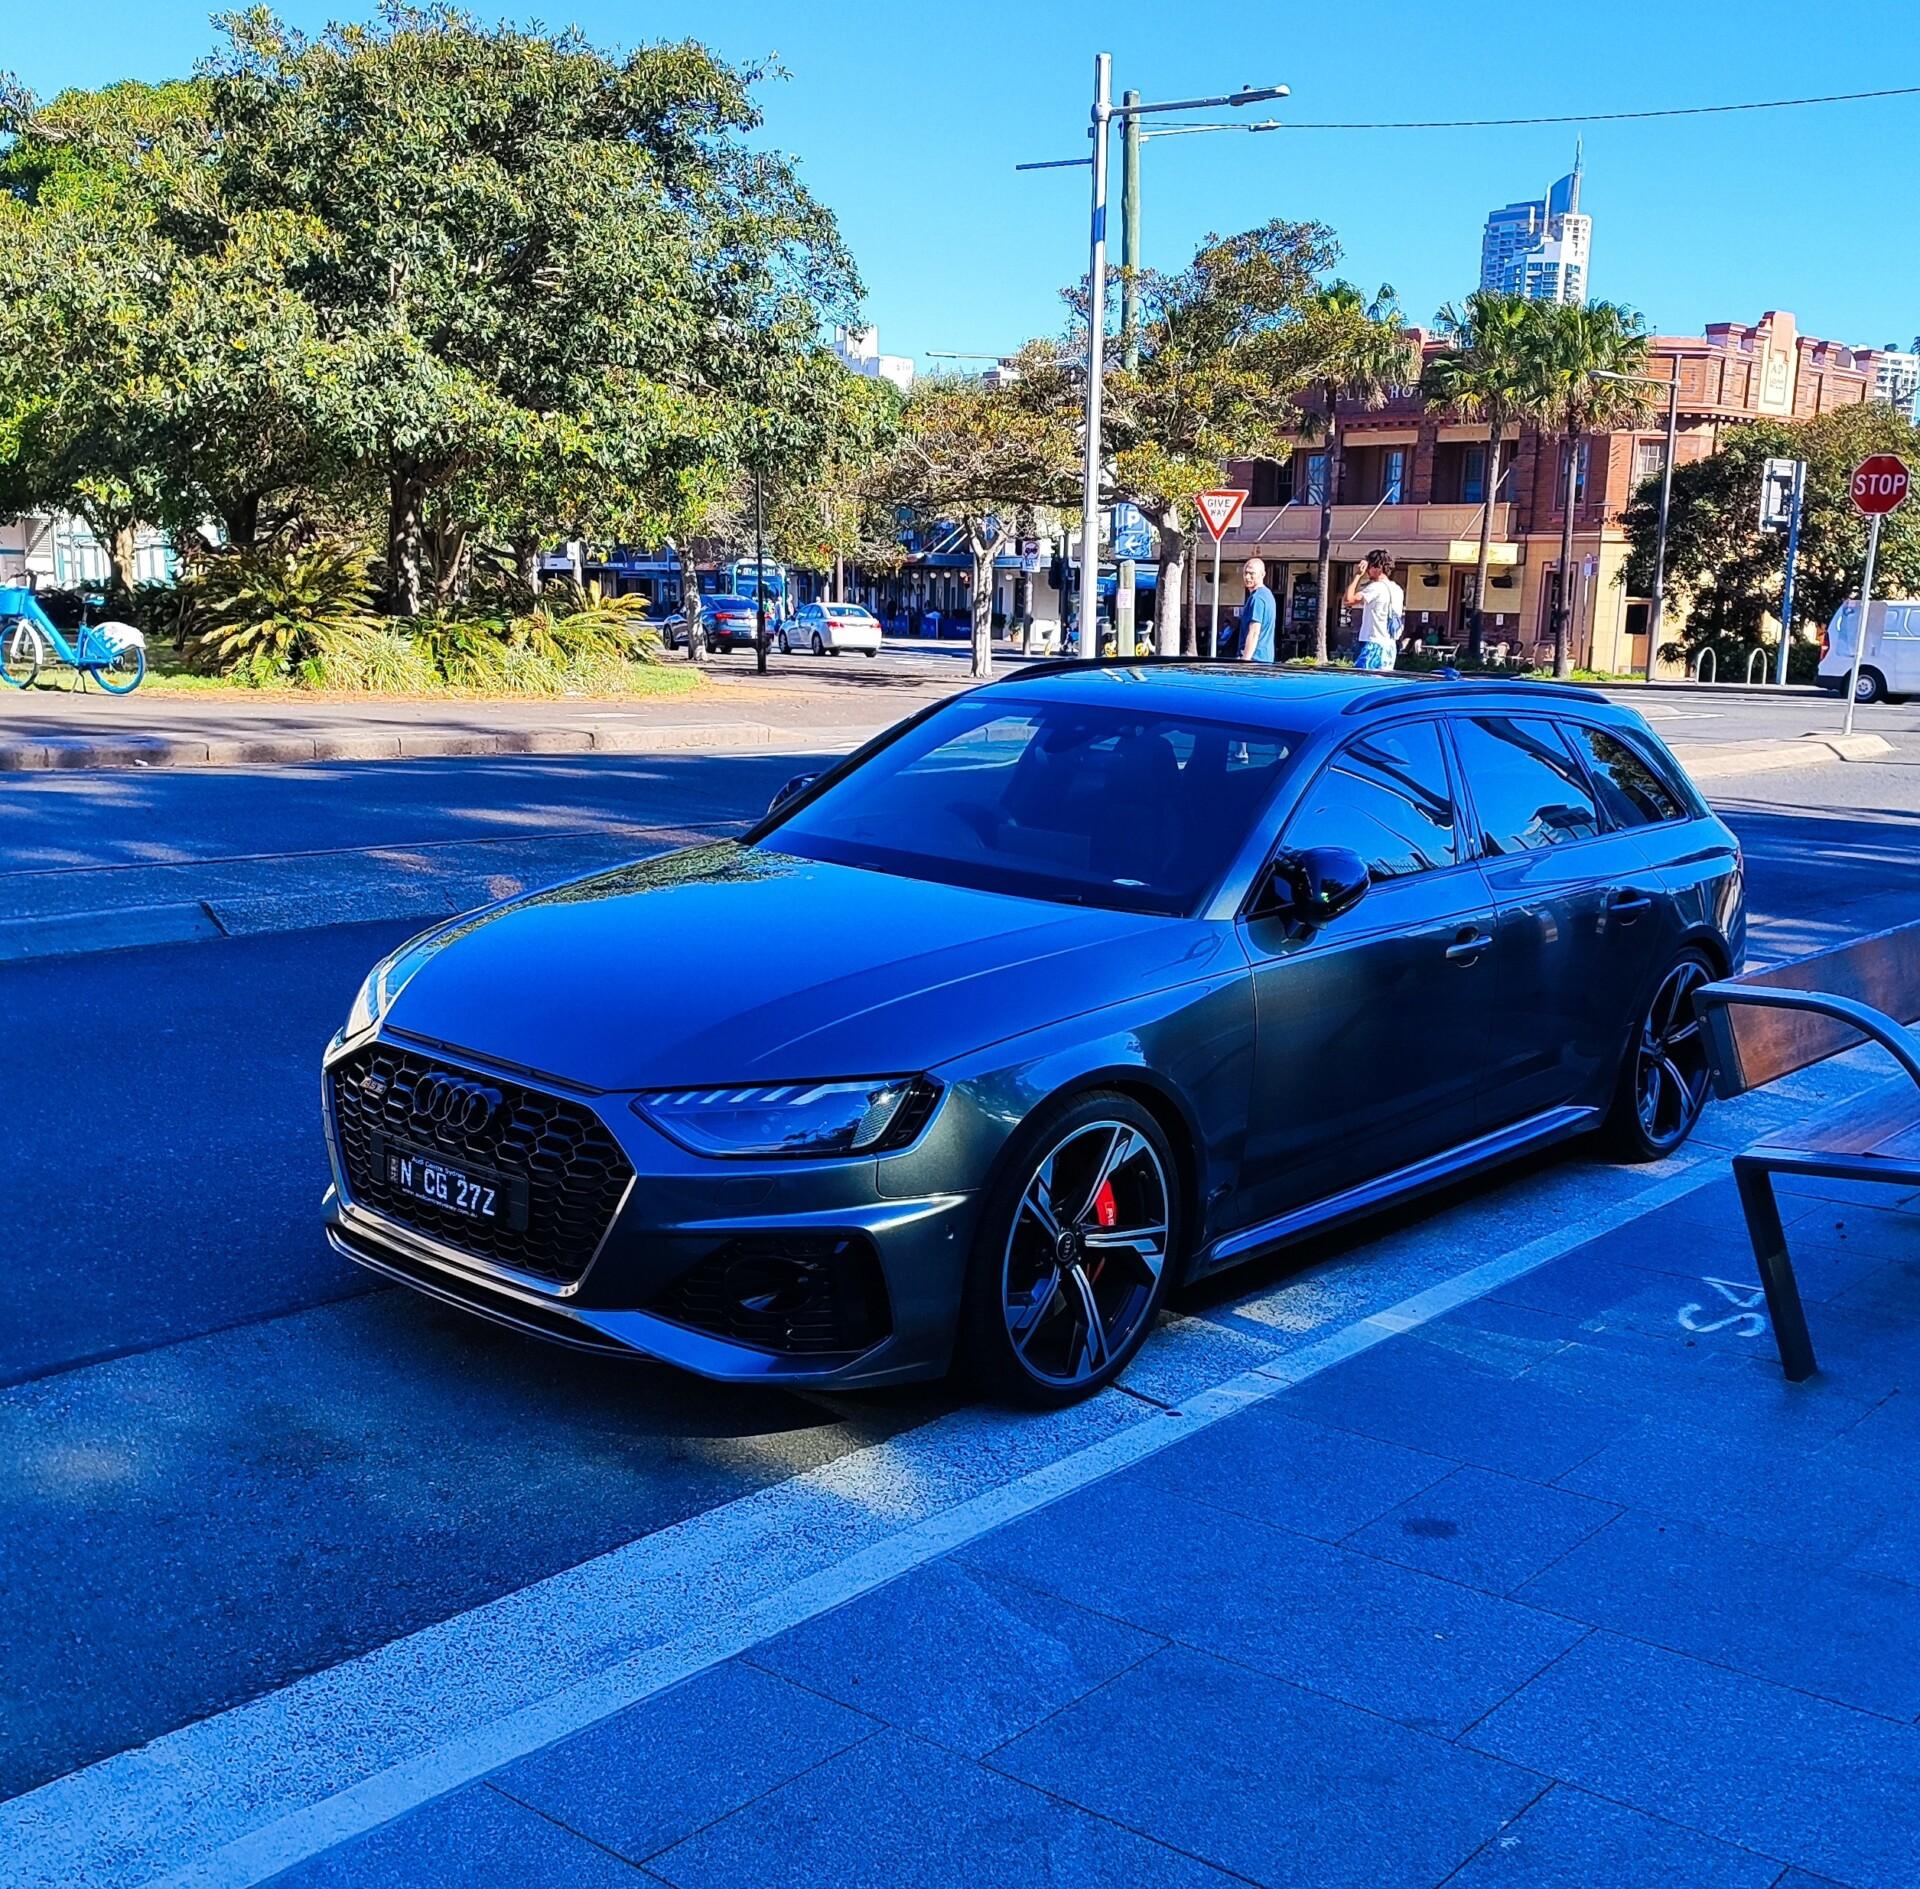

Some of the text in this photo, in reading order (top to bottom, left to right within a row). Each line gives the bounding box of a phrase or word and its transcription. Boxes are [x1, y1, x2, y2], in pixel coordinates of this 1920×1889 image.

[1854, 473, 1906, 496] STOP
[1207, 498, 1231, 508] GIVE
[1127, 510, 1141, 530] P
[411, 1156, 424, 1165] Audi
[401, 1159, 412, 1187] N
[424, 1168, 447, 1200] CG
